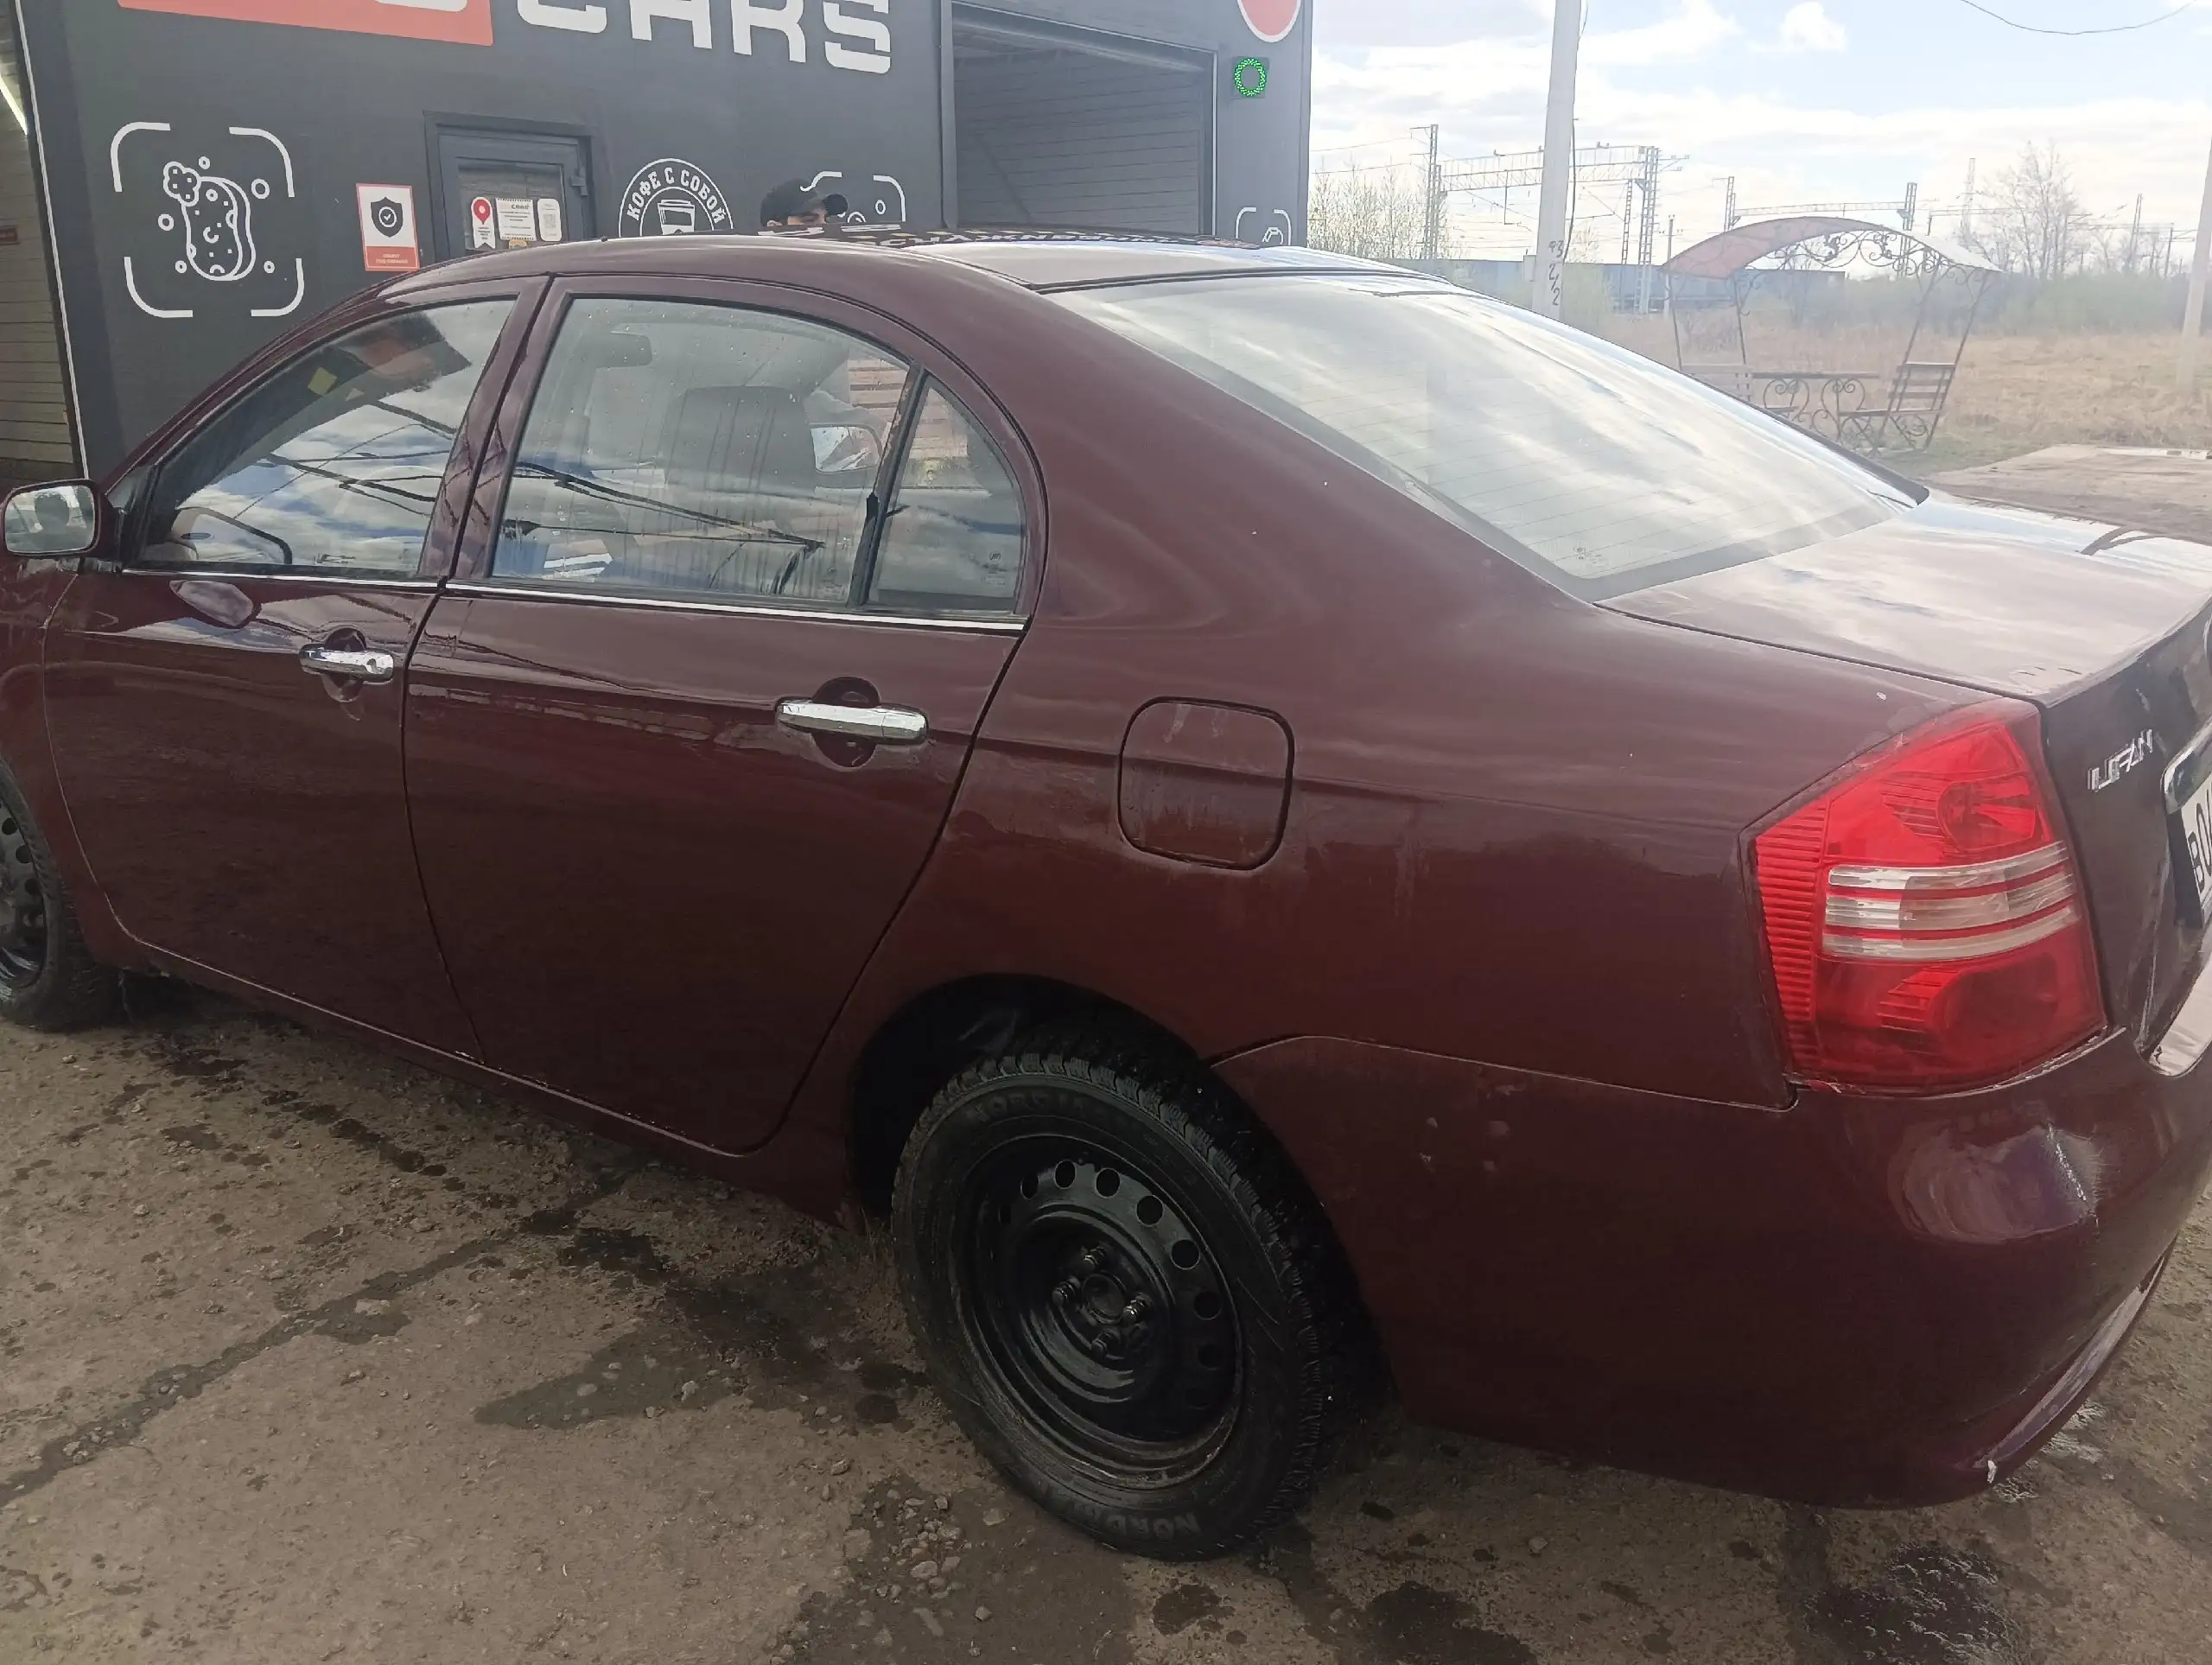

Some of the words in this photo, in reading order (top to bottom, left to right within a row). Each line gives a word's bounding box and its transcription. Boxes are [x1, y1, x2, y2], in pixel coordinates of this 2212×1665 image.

[518, 0, 891, 74] ARS
[626, 171, 661, 221] КОФЕ
[664, 167, 674, 184] С
[680, 169, 726, 224] СОБОЙ
[2087, 728, 2152, 792] LIFAN
